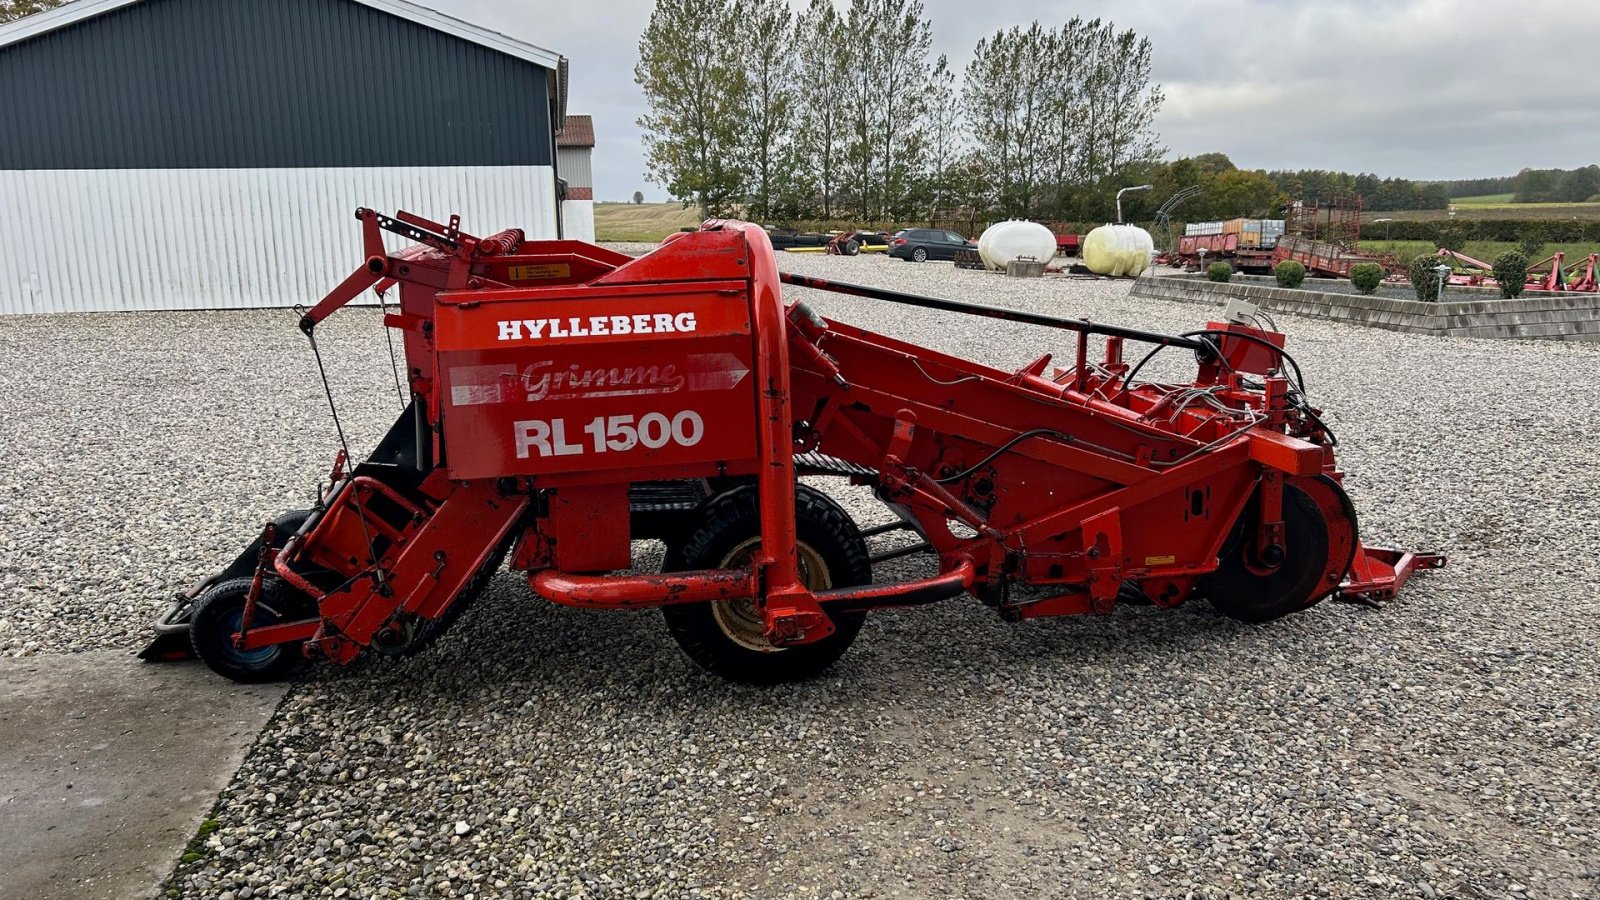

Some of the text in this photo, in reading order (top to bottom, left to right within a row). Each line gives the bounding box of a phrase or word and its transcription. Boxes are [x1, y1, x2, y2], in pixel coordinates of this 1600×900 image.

[497, 312, 697, 340] HYLLEBERG
[523, 360, 685, 401] Grimme
[514, 410, 704, 459] RL 1500
